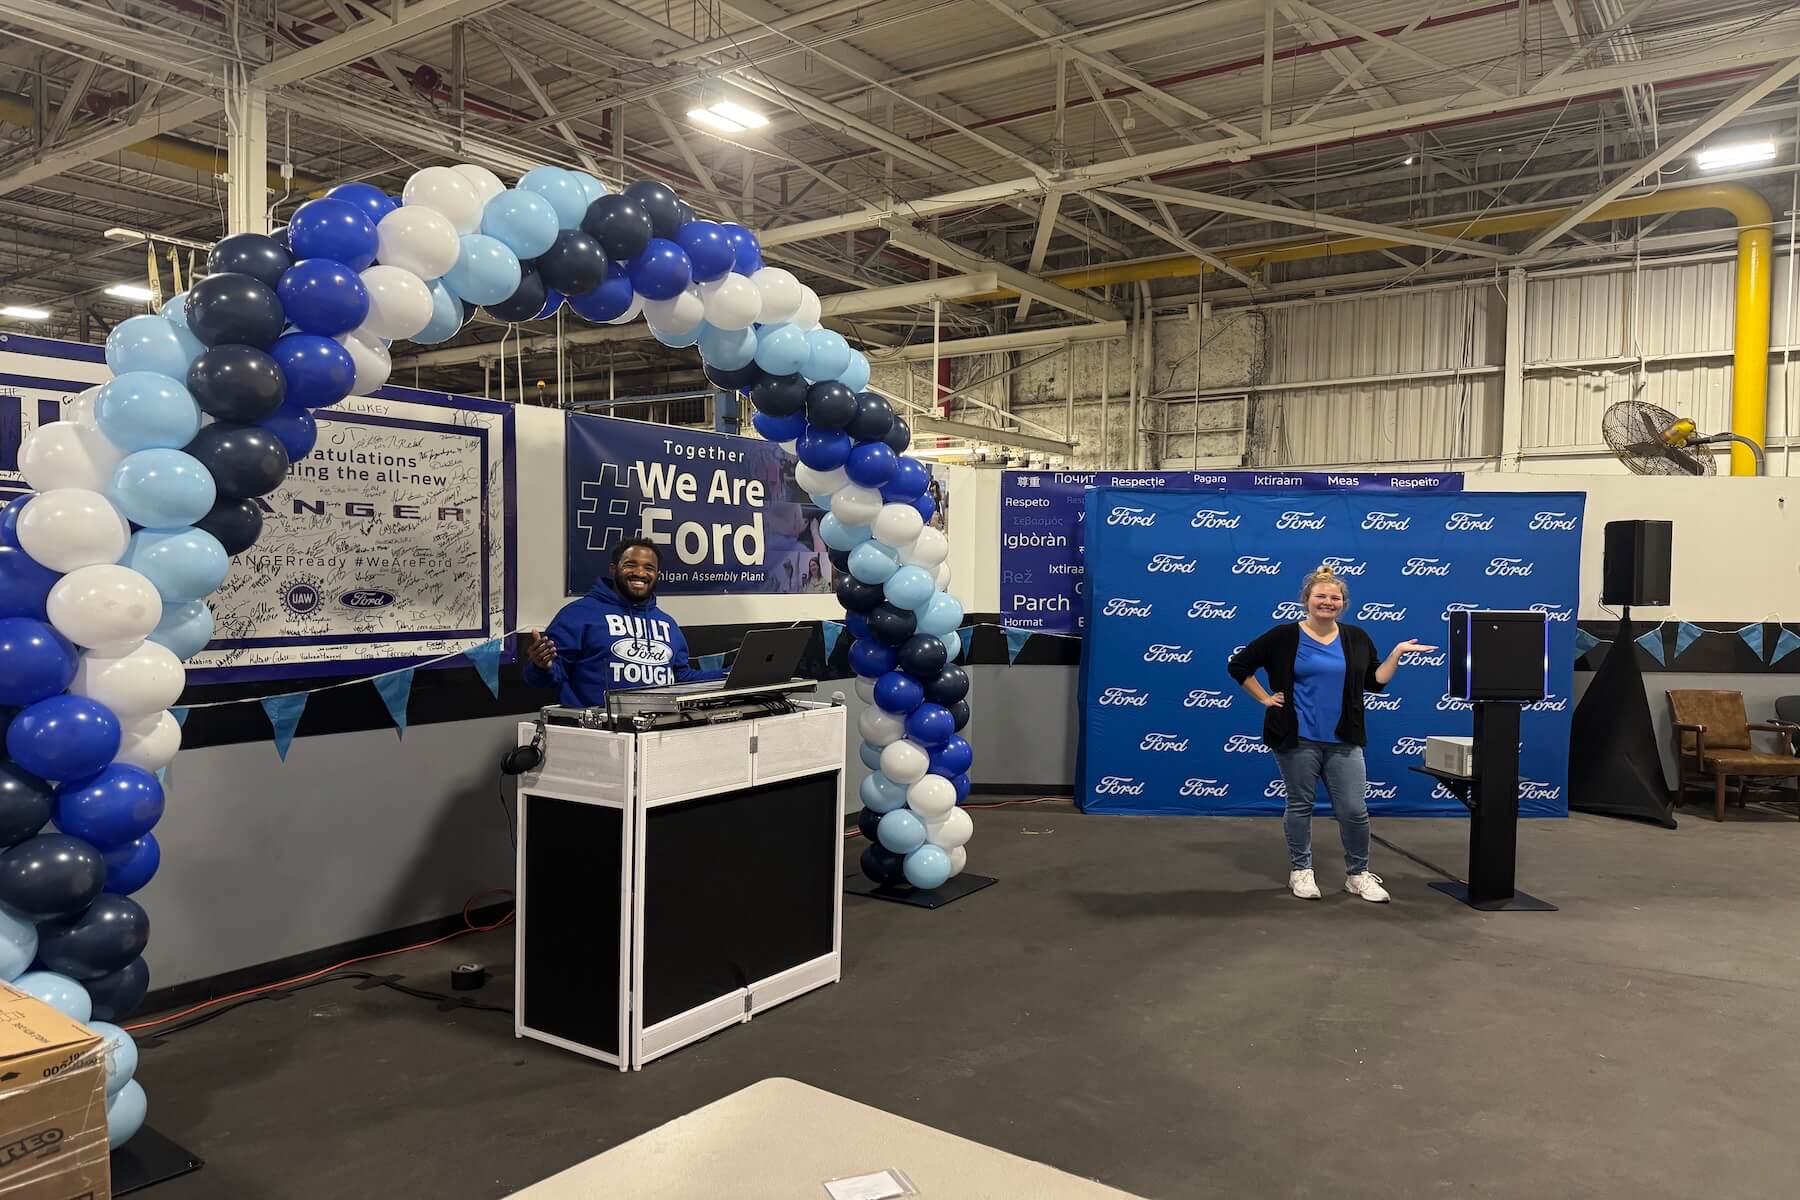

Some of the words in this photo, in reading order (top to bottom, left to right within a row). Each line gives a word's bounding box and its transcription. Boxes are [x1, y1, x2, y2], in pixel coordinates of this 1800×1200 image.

[306, 449, 417, 468] atulations
[663, 440, 745, 463] Together
[336, 466, 369, 481] the
[376, 466, 447, 486] all-new
[635, 460, 698, 503] We
[707, 469, 765, 507] Are
[1193, 474, 1227, 485] Pagara
[1254, 475, 1303, 486] Ixtiraam
[1327, 476, 1360, 486] Meas
[1390, 477, 1440, 489] Respeito
[1005, 497, 1050, 508] Respeto
[1107, 507, 1156, 527] Ford
[1191, 510, 1240, 529] Ford
[1276, 512, 1326, 530] Ford
[1362, 512, 1411, 531] Ford
[1446, 513, 1495, 531] Ford
[1529, 511, 1577, 531] Ford
[641, 507, 765, 566] Ford
[1004, 532, 1067, 549] Igbòràn
[355, 555, 452, 568] #WeAreFord
[1148, 554, 1197, 574] Ford
[1232, 556, 1282, 575] Ford
[1402, 558, 1451, 577] Ford
[1485, 557, 1534, 577] Ford
[691, 571, 738, 583] Assembly
[741, 571, 765, 581] Plant
[292, 592, 314, 605] UAW
[350, 591, 384, 606] Ford
[1013, 594, 1070, 611] Parch
[1103, 598, 1153, 618] Ford
[1188, 600, 1237, 619] Ford
[1272, 602, 1309, 620] For
[1357, 603, 1407, 621] Ford
[605, 614, 671, 643] BUILT
[1004, 617, 1043, 627] Hormat
[627, 641, 665, 660] Ford
[1144, 644, 1193, 663] Ford
[1100, 688, 1149, 707] Ford
[1184, 690, 1233, 709] Ford
[1140, 733, 1189, 752] Ford
[1392, 736, 1427, 755] For
[1095, 776, 1145, 795] Ford
[1180, 778, 1229, 797] Ford
